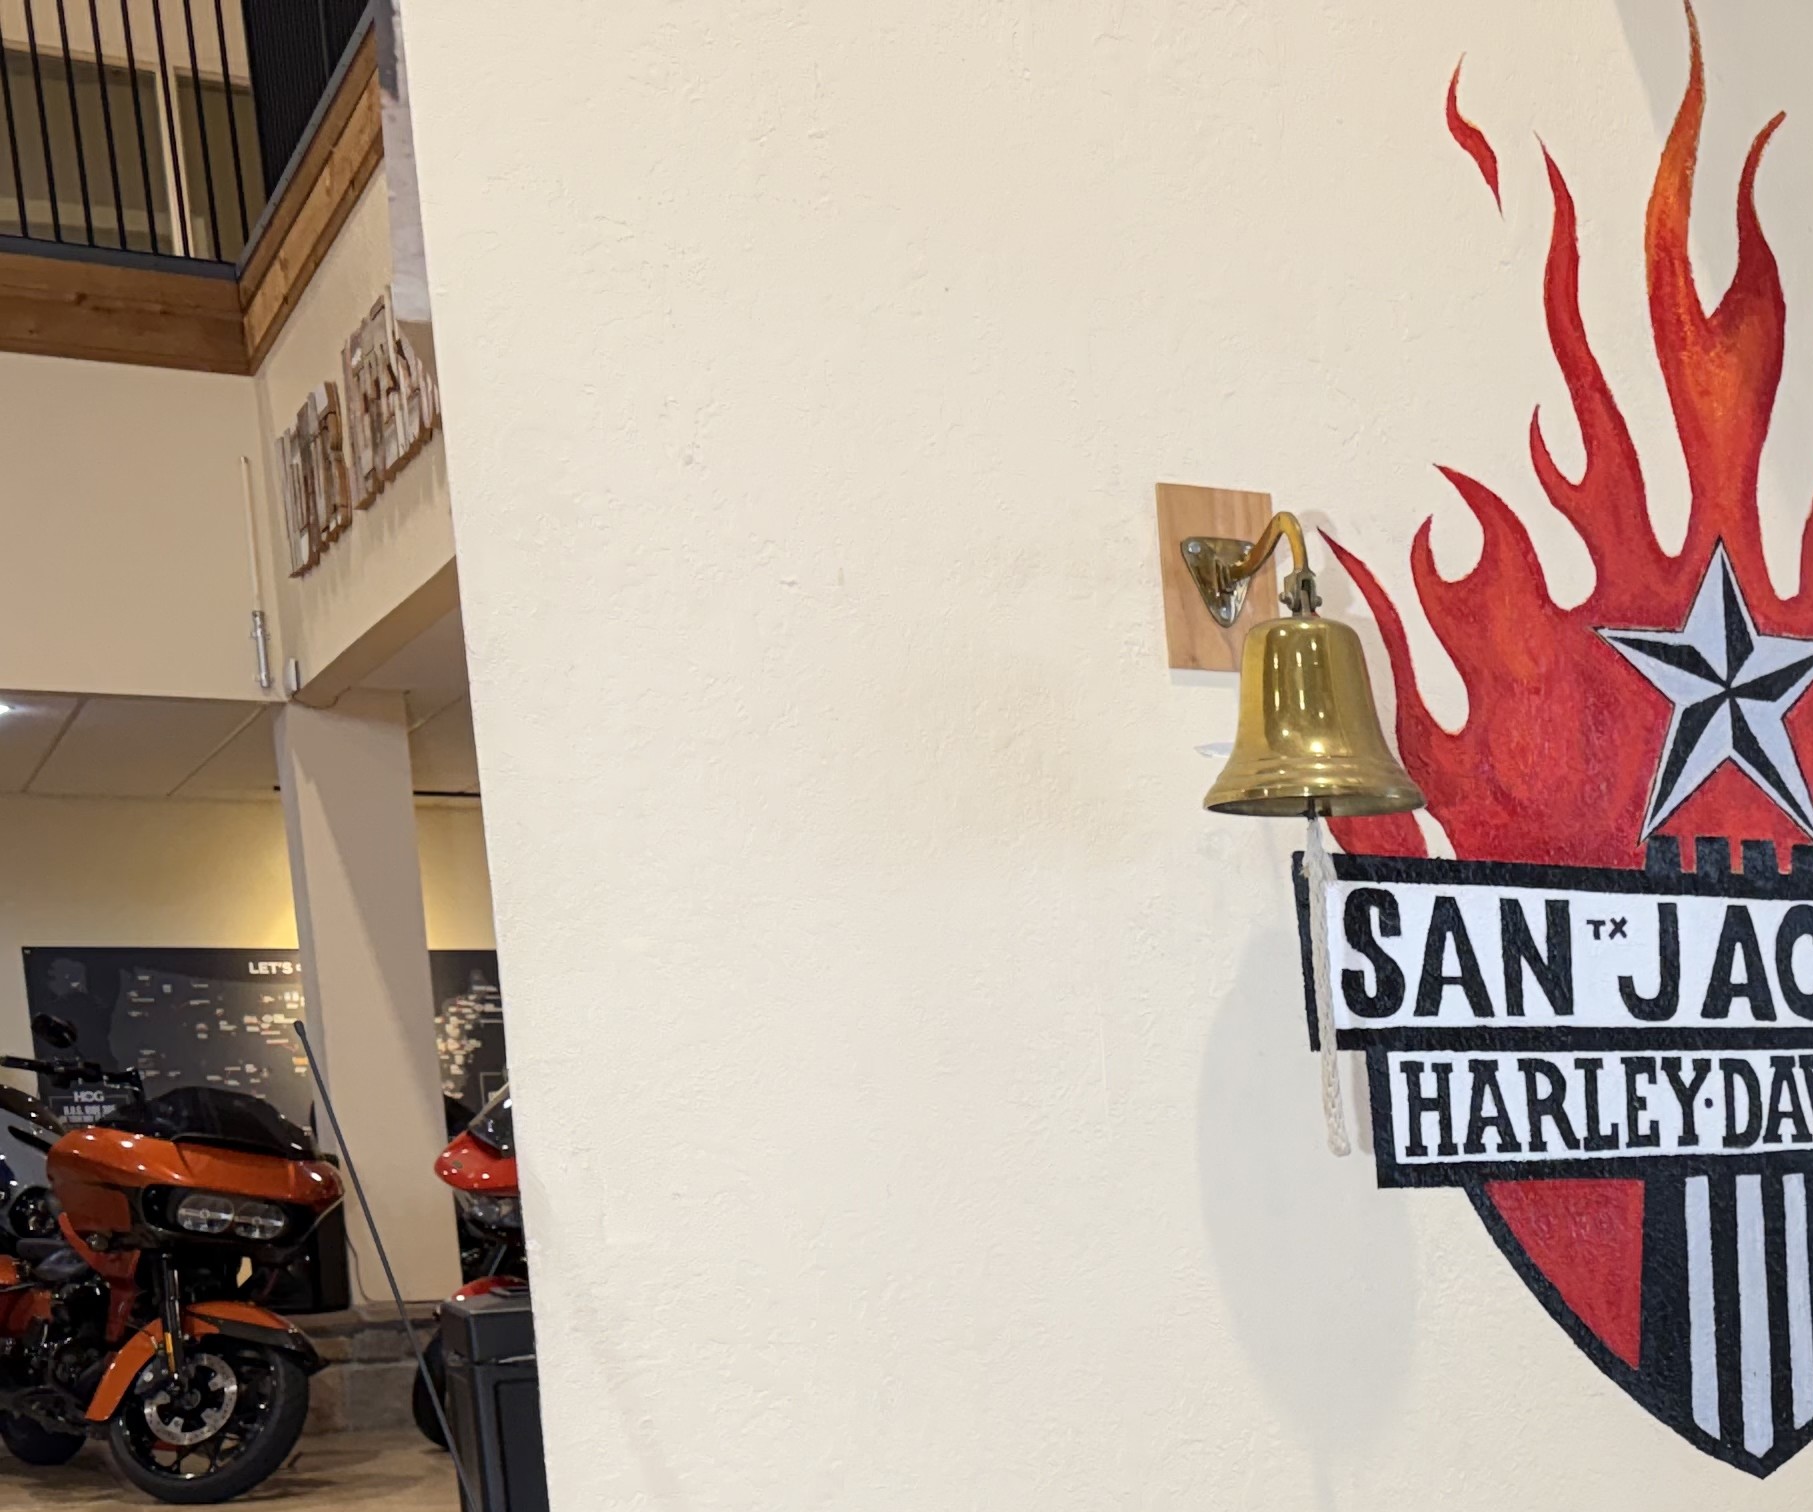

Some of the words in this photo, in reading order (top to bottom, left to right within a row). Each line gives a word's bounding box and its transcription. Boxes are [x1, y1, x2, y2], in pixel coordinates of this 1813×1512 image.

[248, 961, 293, 974] LET'S
[1340, 887, 1574, 1019] SAN
[1586, 917, 1628, 941] TX
